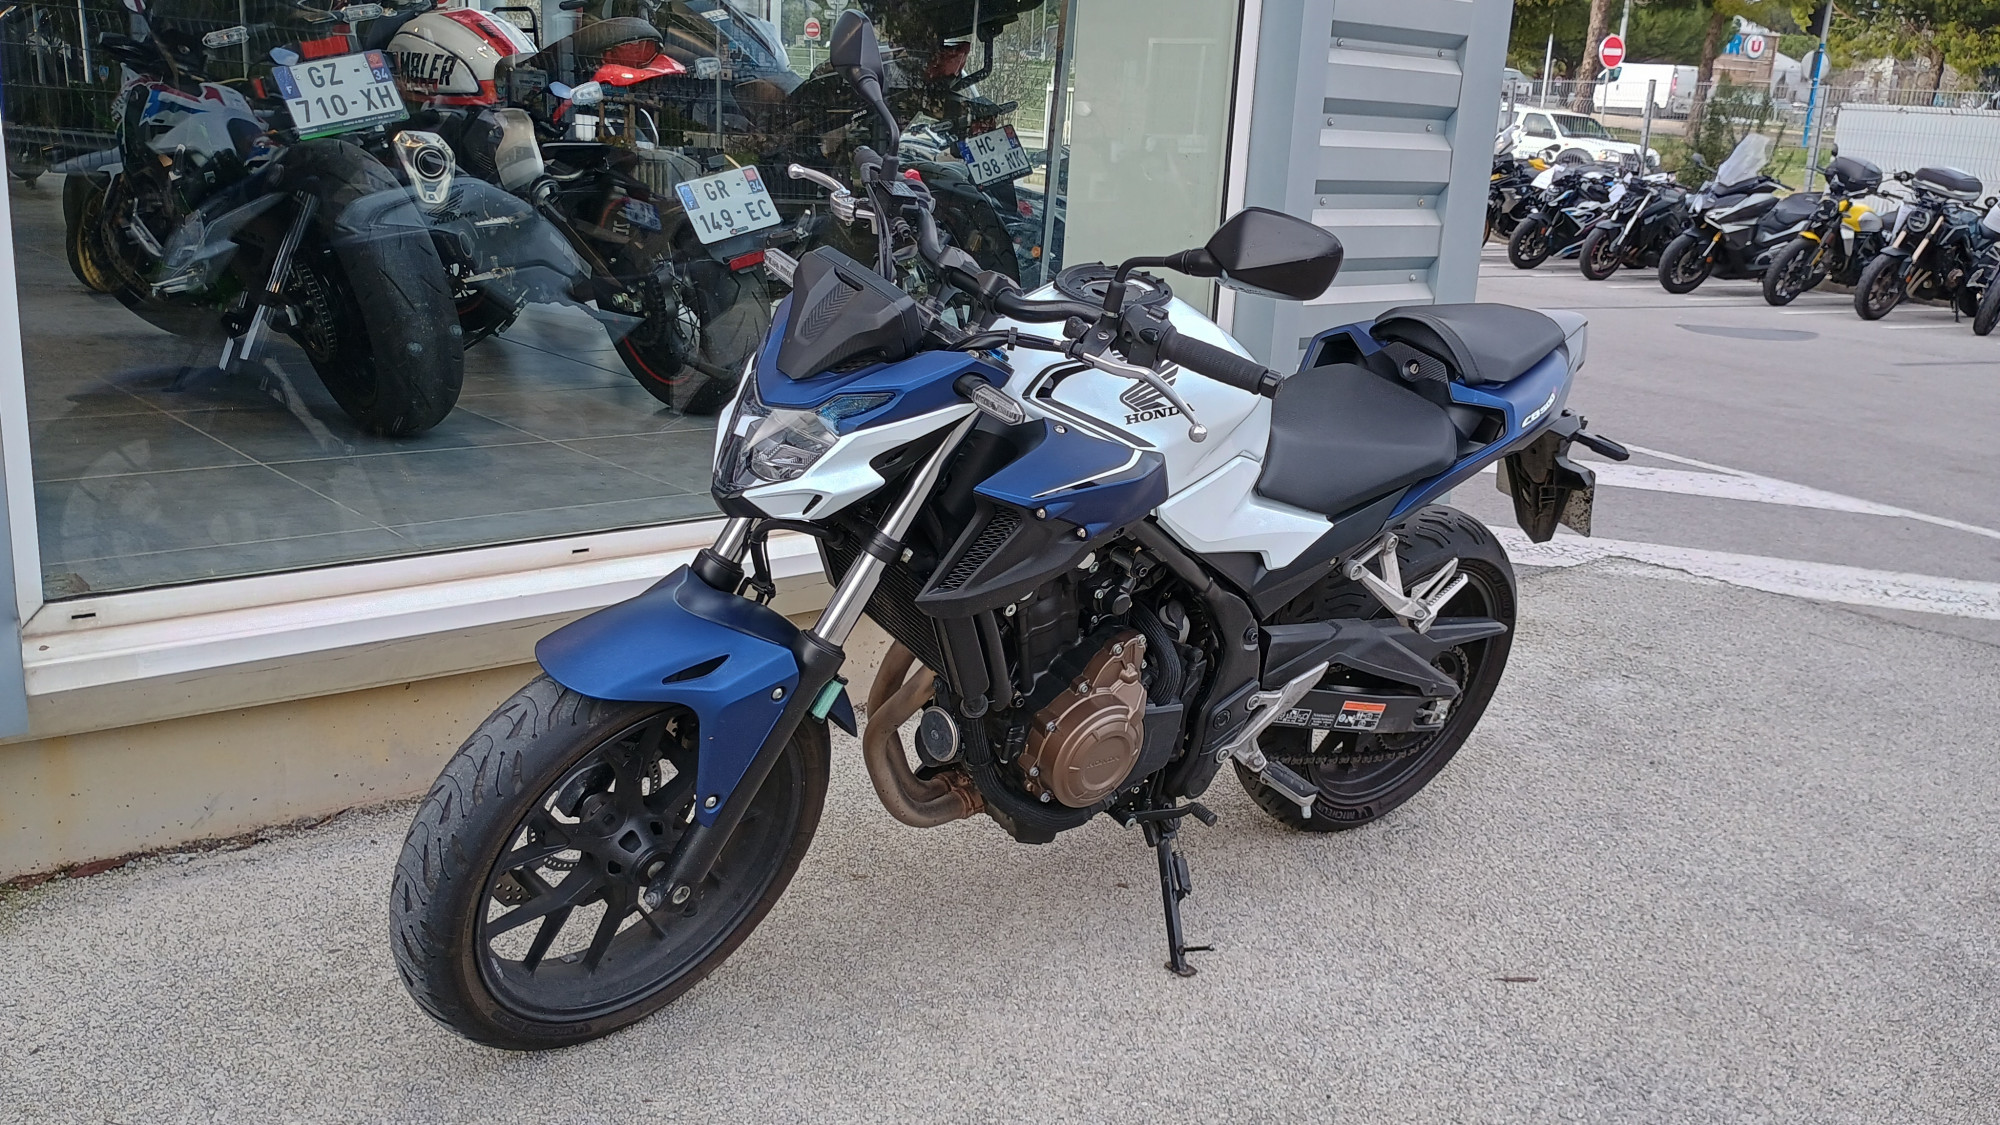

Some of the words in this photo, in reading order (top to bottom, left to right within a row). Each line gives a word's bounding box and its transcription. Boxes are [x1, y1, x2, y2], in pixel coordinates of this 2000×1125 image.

[1751, 41, 1762, 52] U
[307, 62, 344, 89] GZ
[373, 67, 389, 81] 34
[400, 51, 459, 86] MBLER
[286, 85, 293, 95] F
[295, 85, 396, 124] 710-XH
[975, 136, 996, 156] HC
[972, 150, 1025, 180] 798-NK
[703, 179, 731, 202] GR
[750, 180, 762, 192] 34
[699, 199, 772, 234] 149-EC
[1124, 403, 1196, 425] HOND
